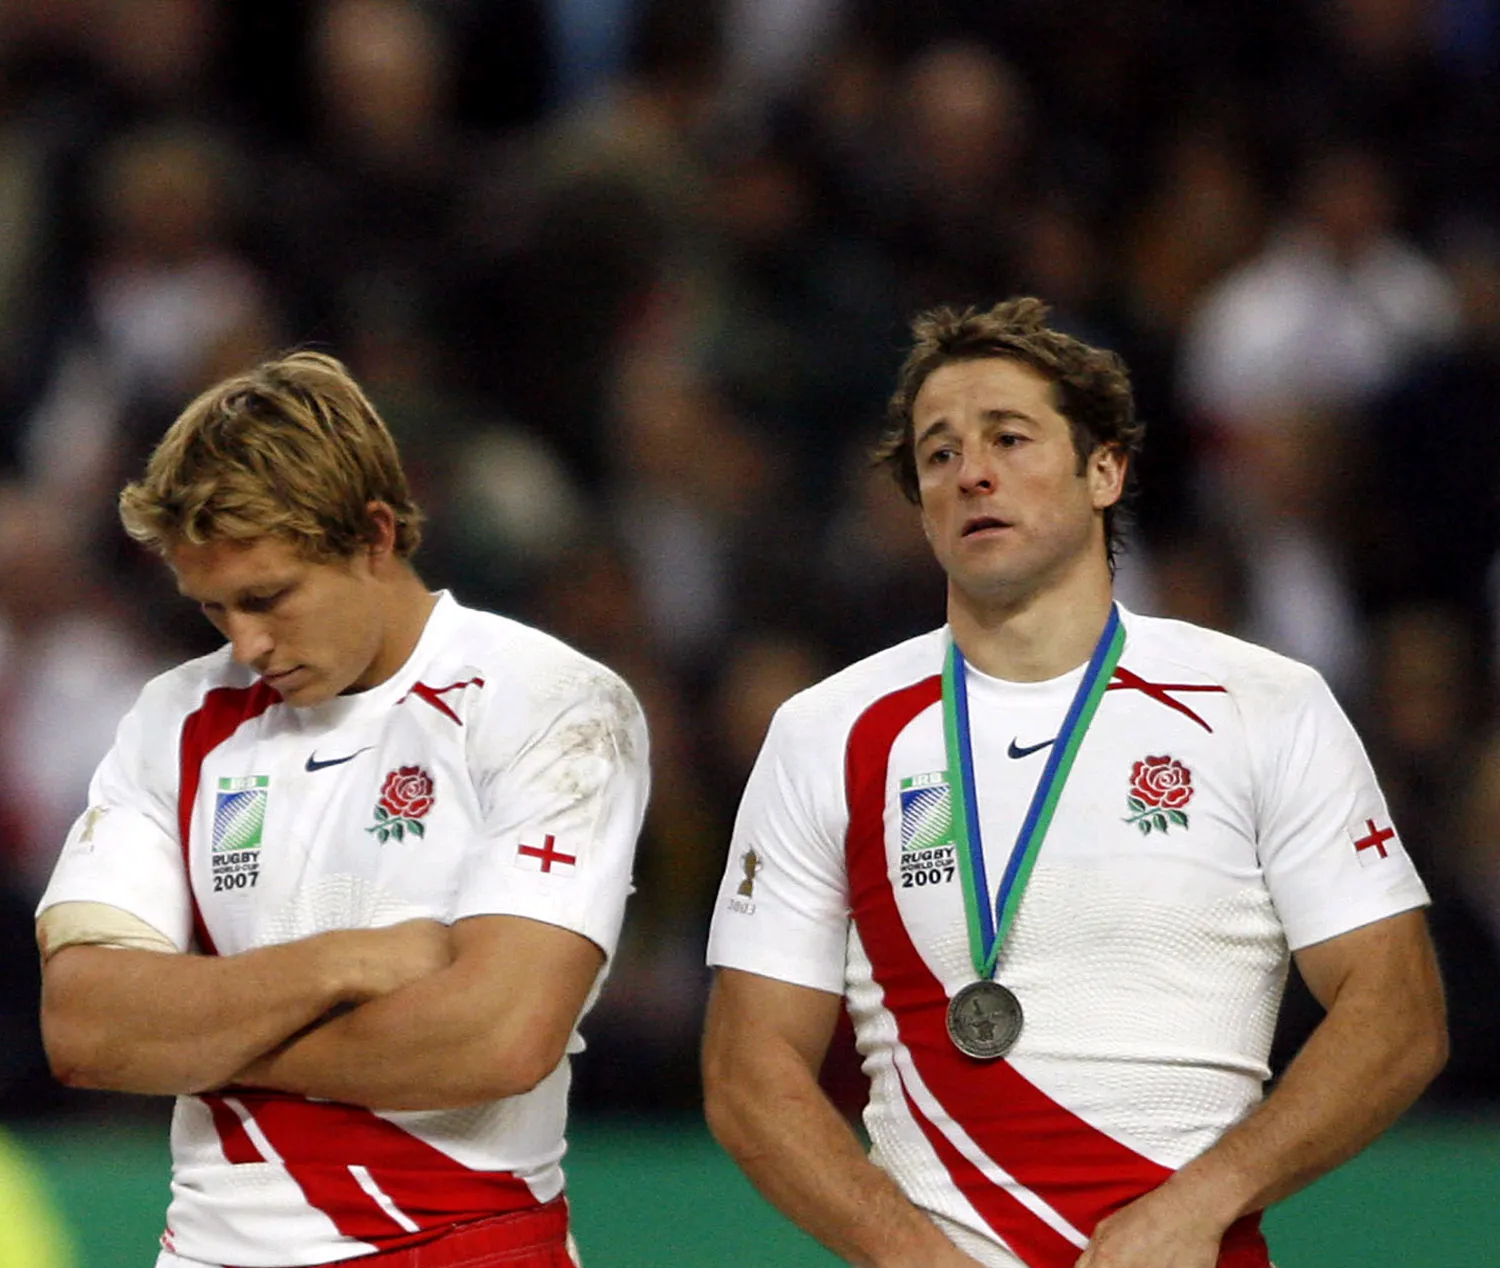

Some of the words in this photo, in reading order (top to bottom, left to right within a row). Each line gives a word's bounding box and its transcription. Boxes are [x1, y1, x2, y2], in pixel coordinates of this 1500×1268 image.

[212, 850, 260, 867] RUGBY
[901, 847, 955, 865] RUGBY
[901, 861, 934, 872] WORLD
[934, 858, 954, 868] CUP
[213, 871, 259, 892] 2007
[902, 867, 955, 888] 2007
